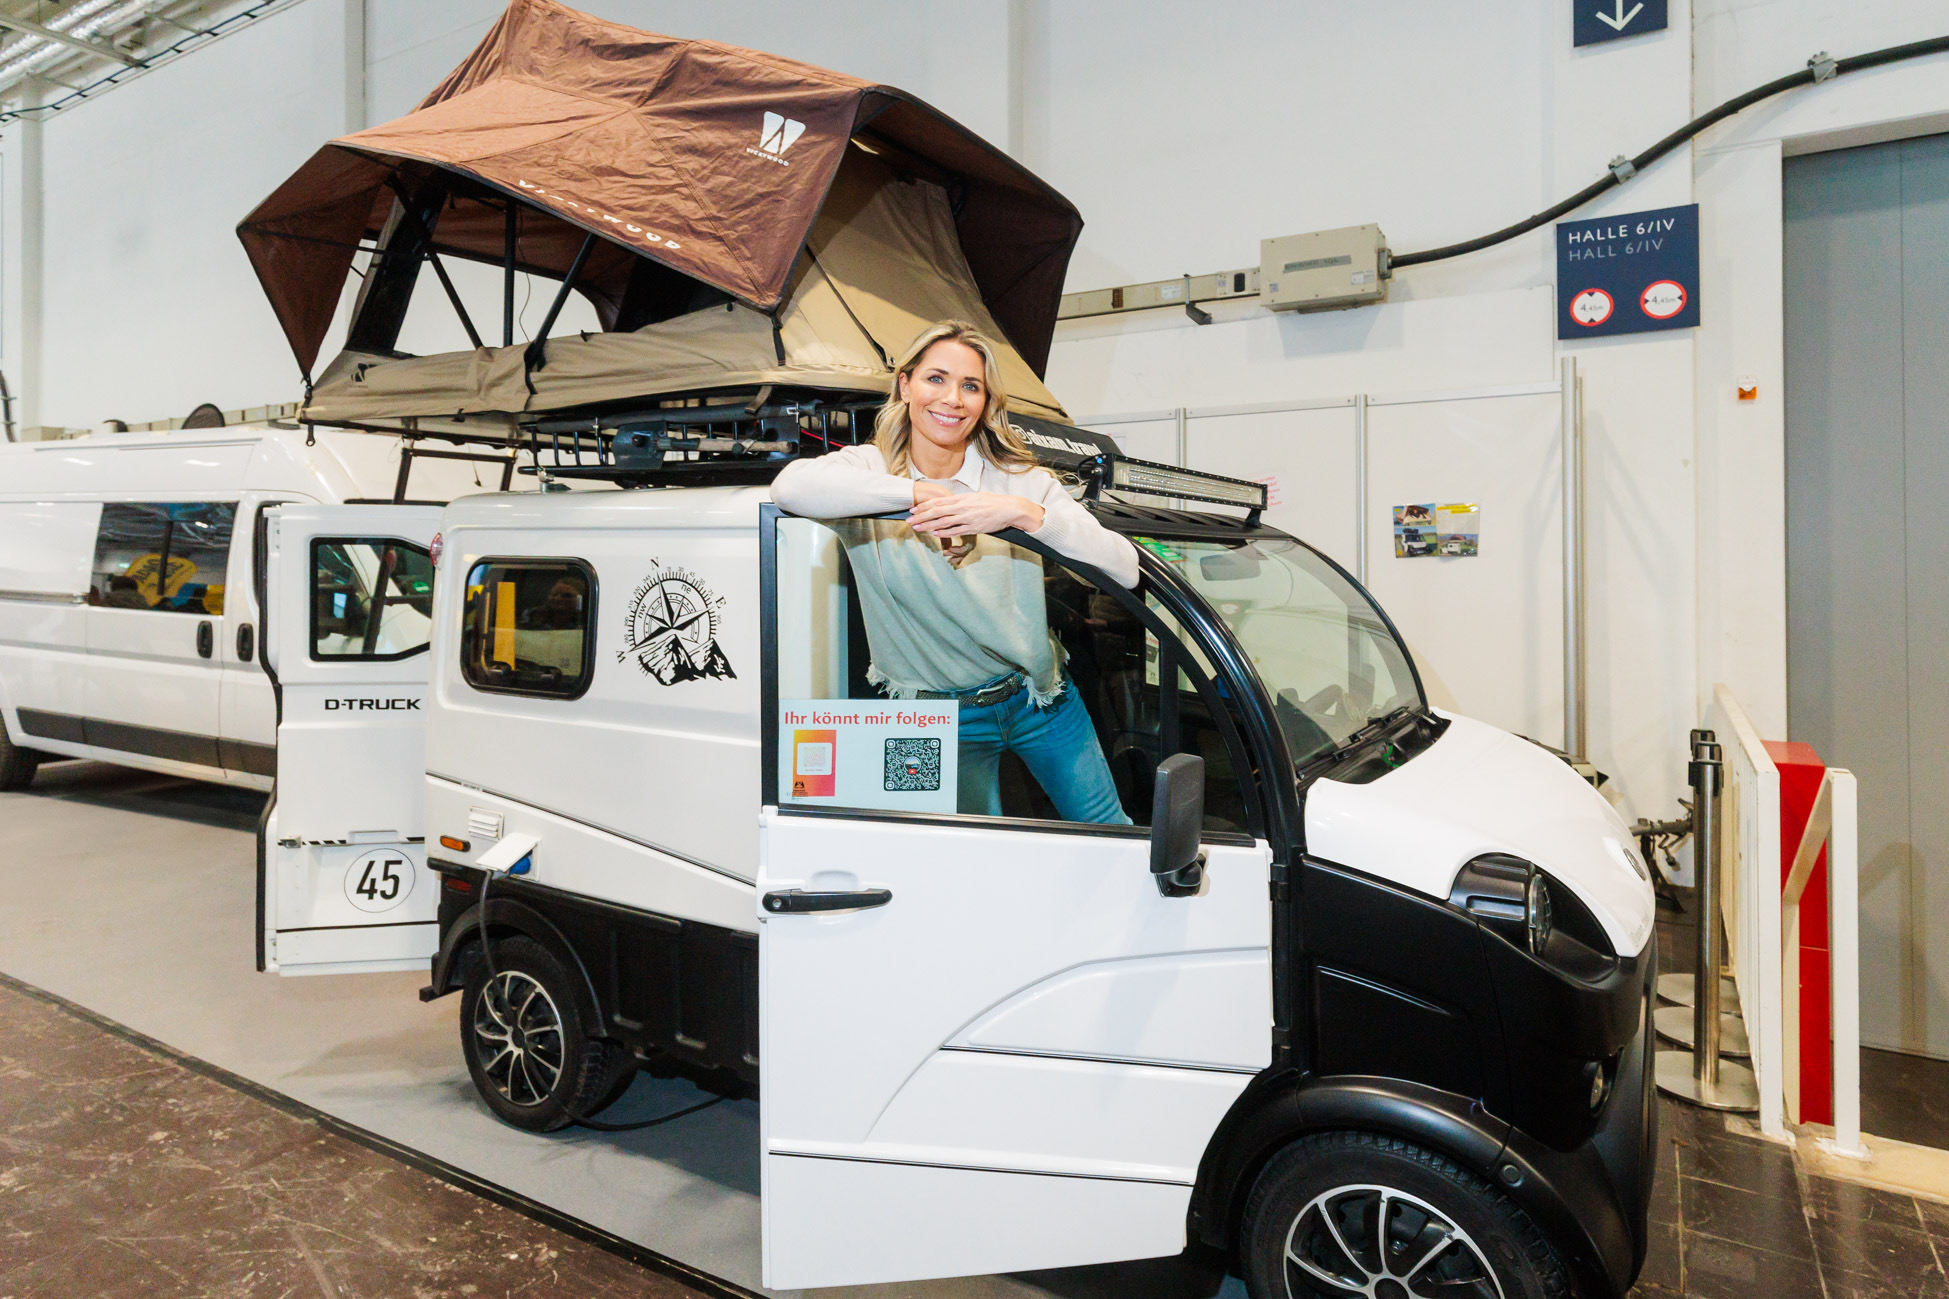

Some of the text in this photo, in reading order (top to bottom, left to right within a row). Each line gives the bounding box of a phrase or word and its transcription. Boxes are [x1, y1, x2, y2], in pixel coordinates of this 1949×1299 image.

[1568, 218, 1675, 245] HALLE 6/IV
[1569, 238, 1663, 262] HALL 6/IV
[681, 583, 692, 595] ne
[715, 595, 727, 609] E
[324, 698, 421, 711] D-TRUCK
[784, 711, 951, 728] Ihr könnt mir folgen:
[356, 859, 403, 901] 45
